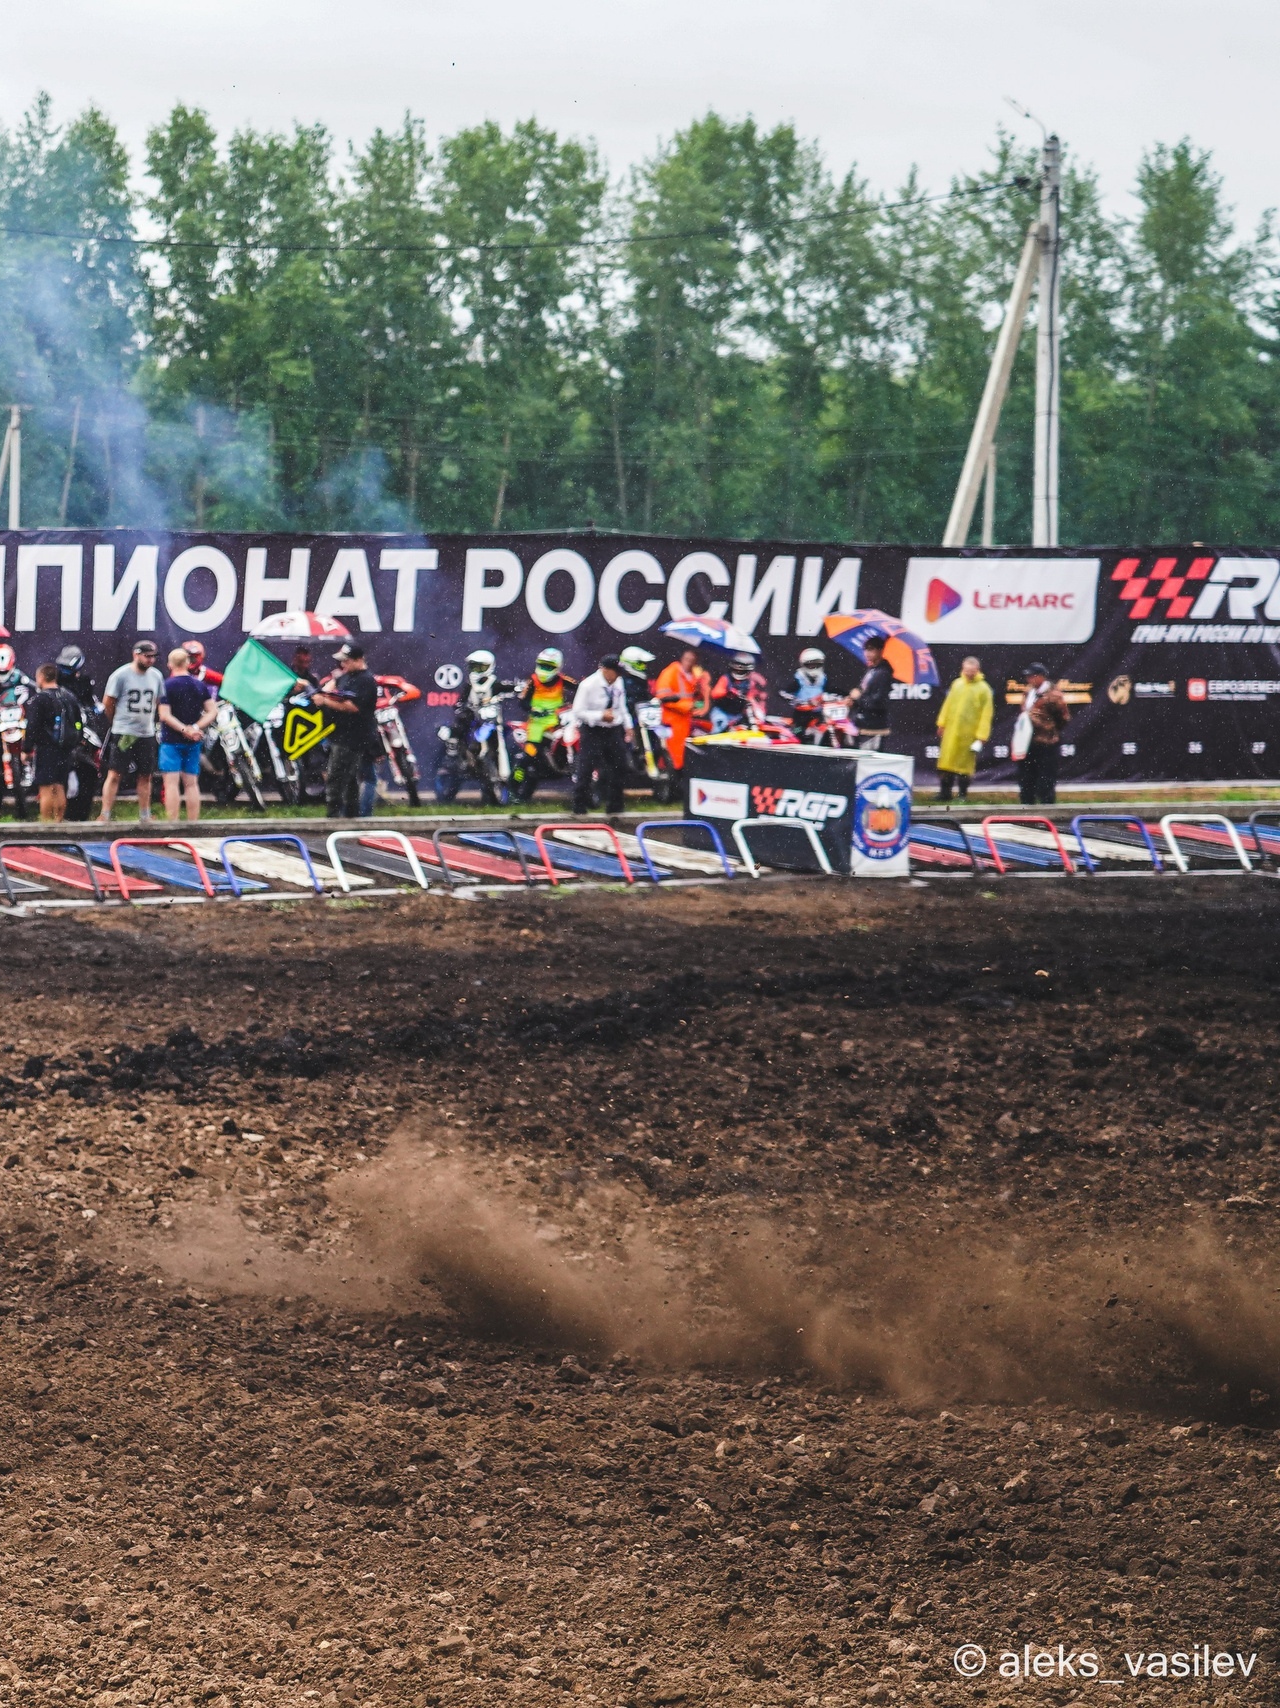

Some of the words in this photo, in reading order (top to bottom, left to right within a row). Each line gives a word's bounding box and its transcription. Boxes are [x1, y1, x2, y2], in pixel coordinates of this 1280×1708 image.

[461, 548, 863, 637] РОССИИ
[127, 689, 154, 714] 23
[775, 789, 848, 821] RGP
